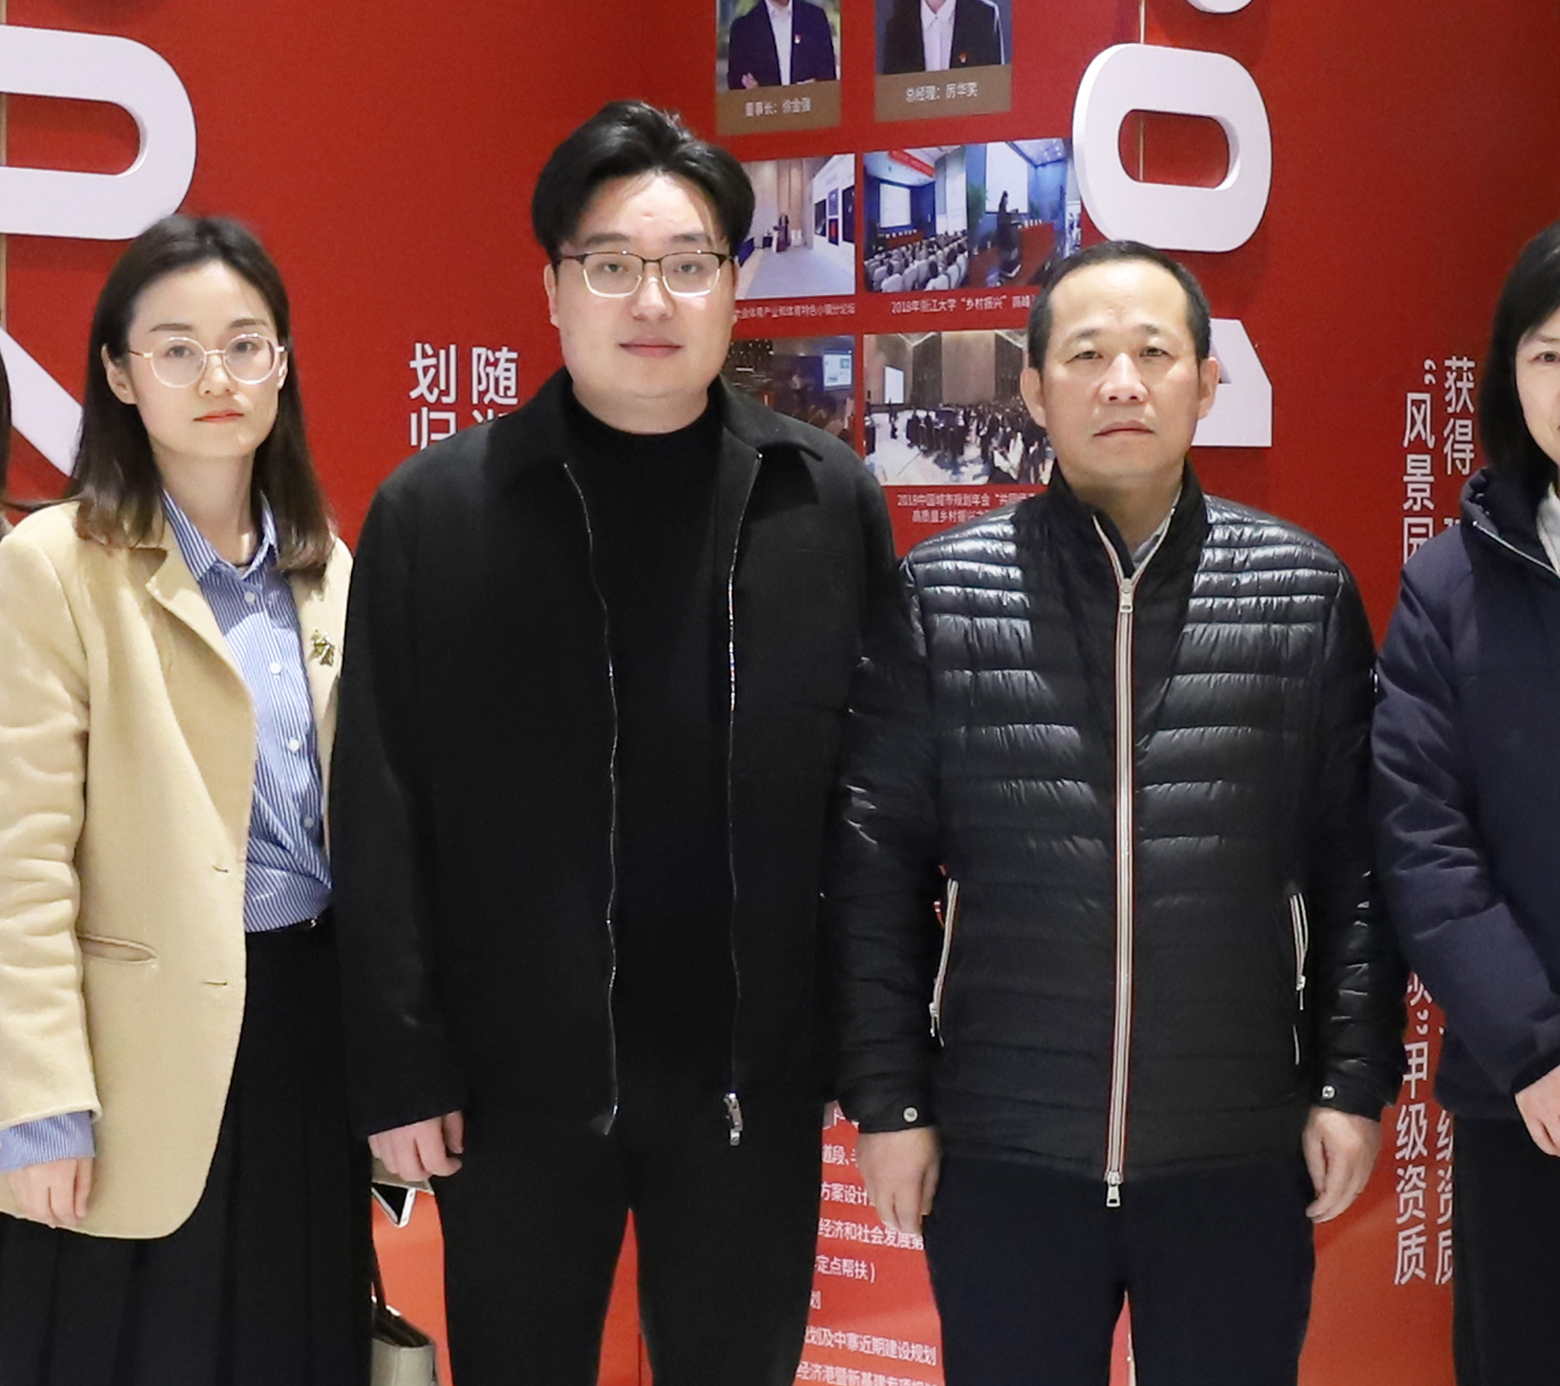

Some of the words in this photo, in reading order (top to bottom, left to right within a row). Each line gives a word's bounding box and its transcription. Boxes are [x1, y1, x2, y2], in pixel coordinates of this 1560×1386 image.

[471, 346, 519, 423] 随
[820, 1181, 876, 1207] 方案设计
